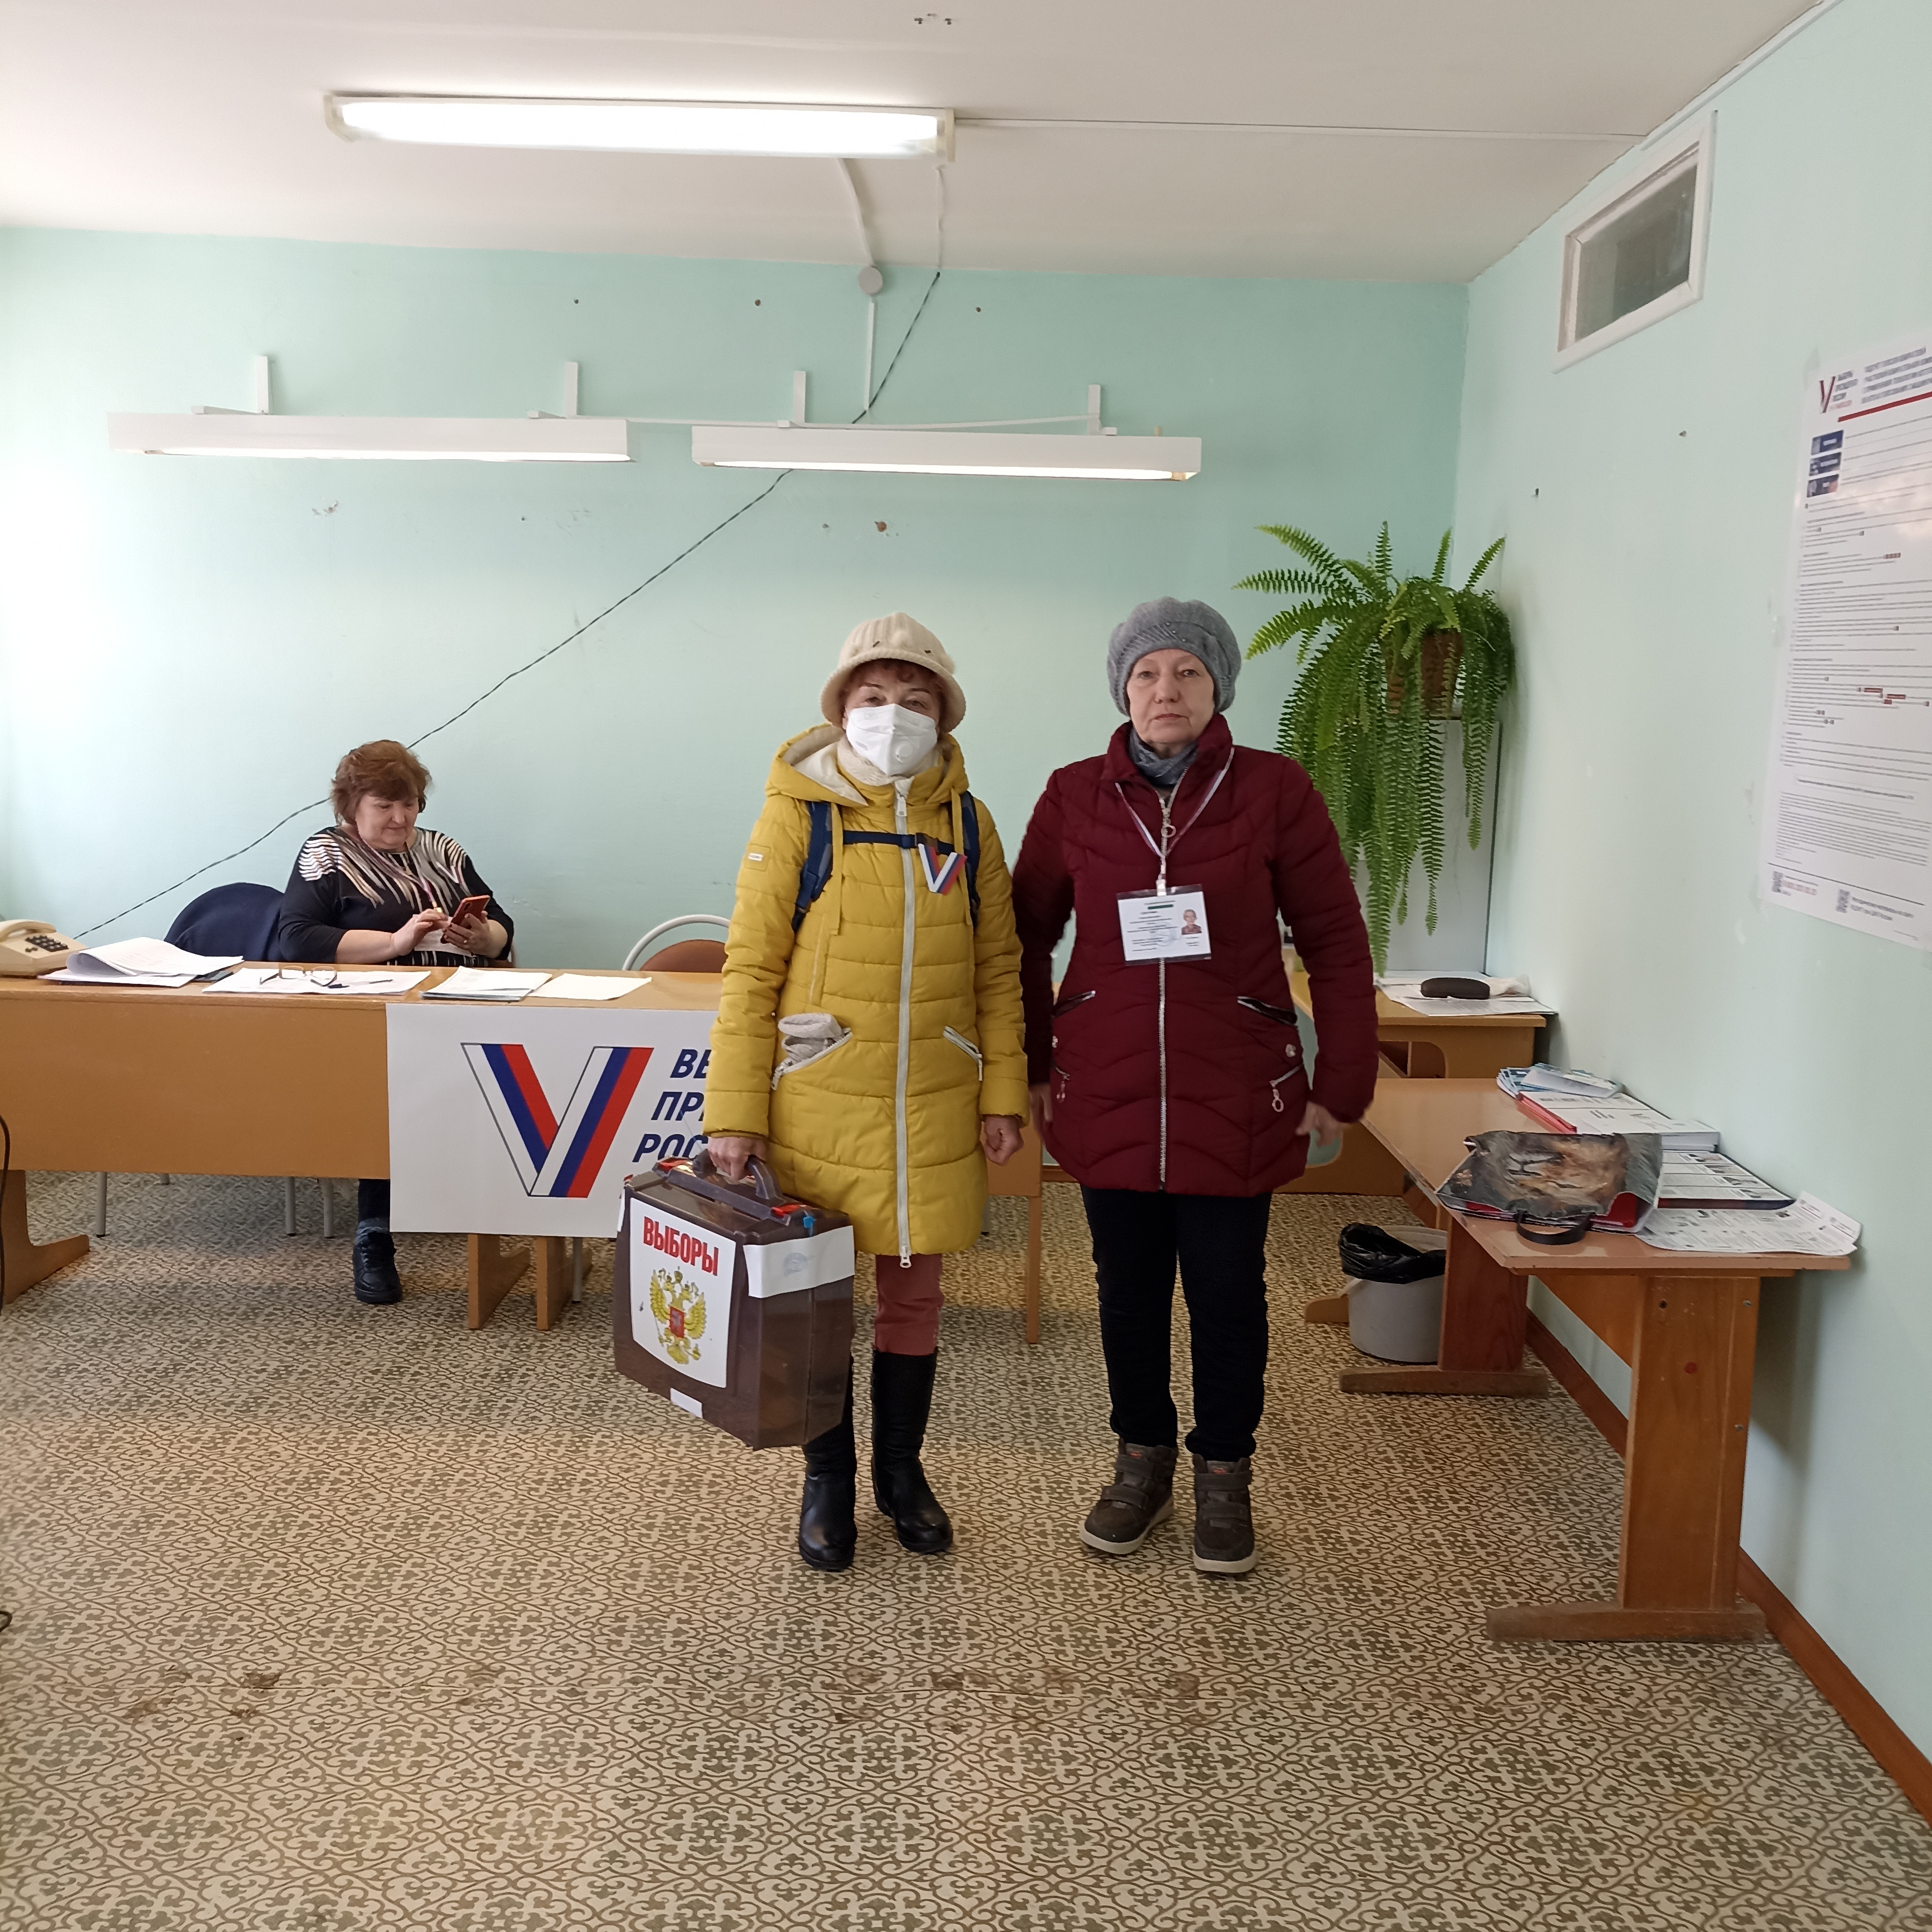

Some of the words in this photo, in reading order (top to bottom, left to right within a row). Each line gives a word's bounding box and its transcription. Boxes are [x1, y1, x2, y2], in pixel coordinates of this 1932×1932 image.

[461, 1043, 654, 1197] V
[650, 1091, 704, 1121] ПР
[643, 1216, 718, 1276] ВЫБОРЫ
